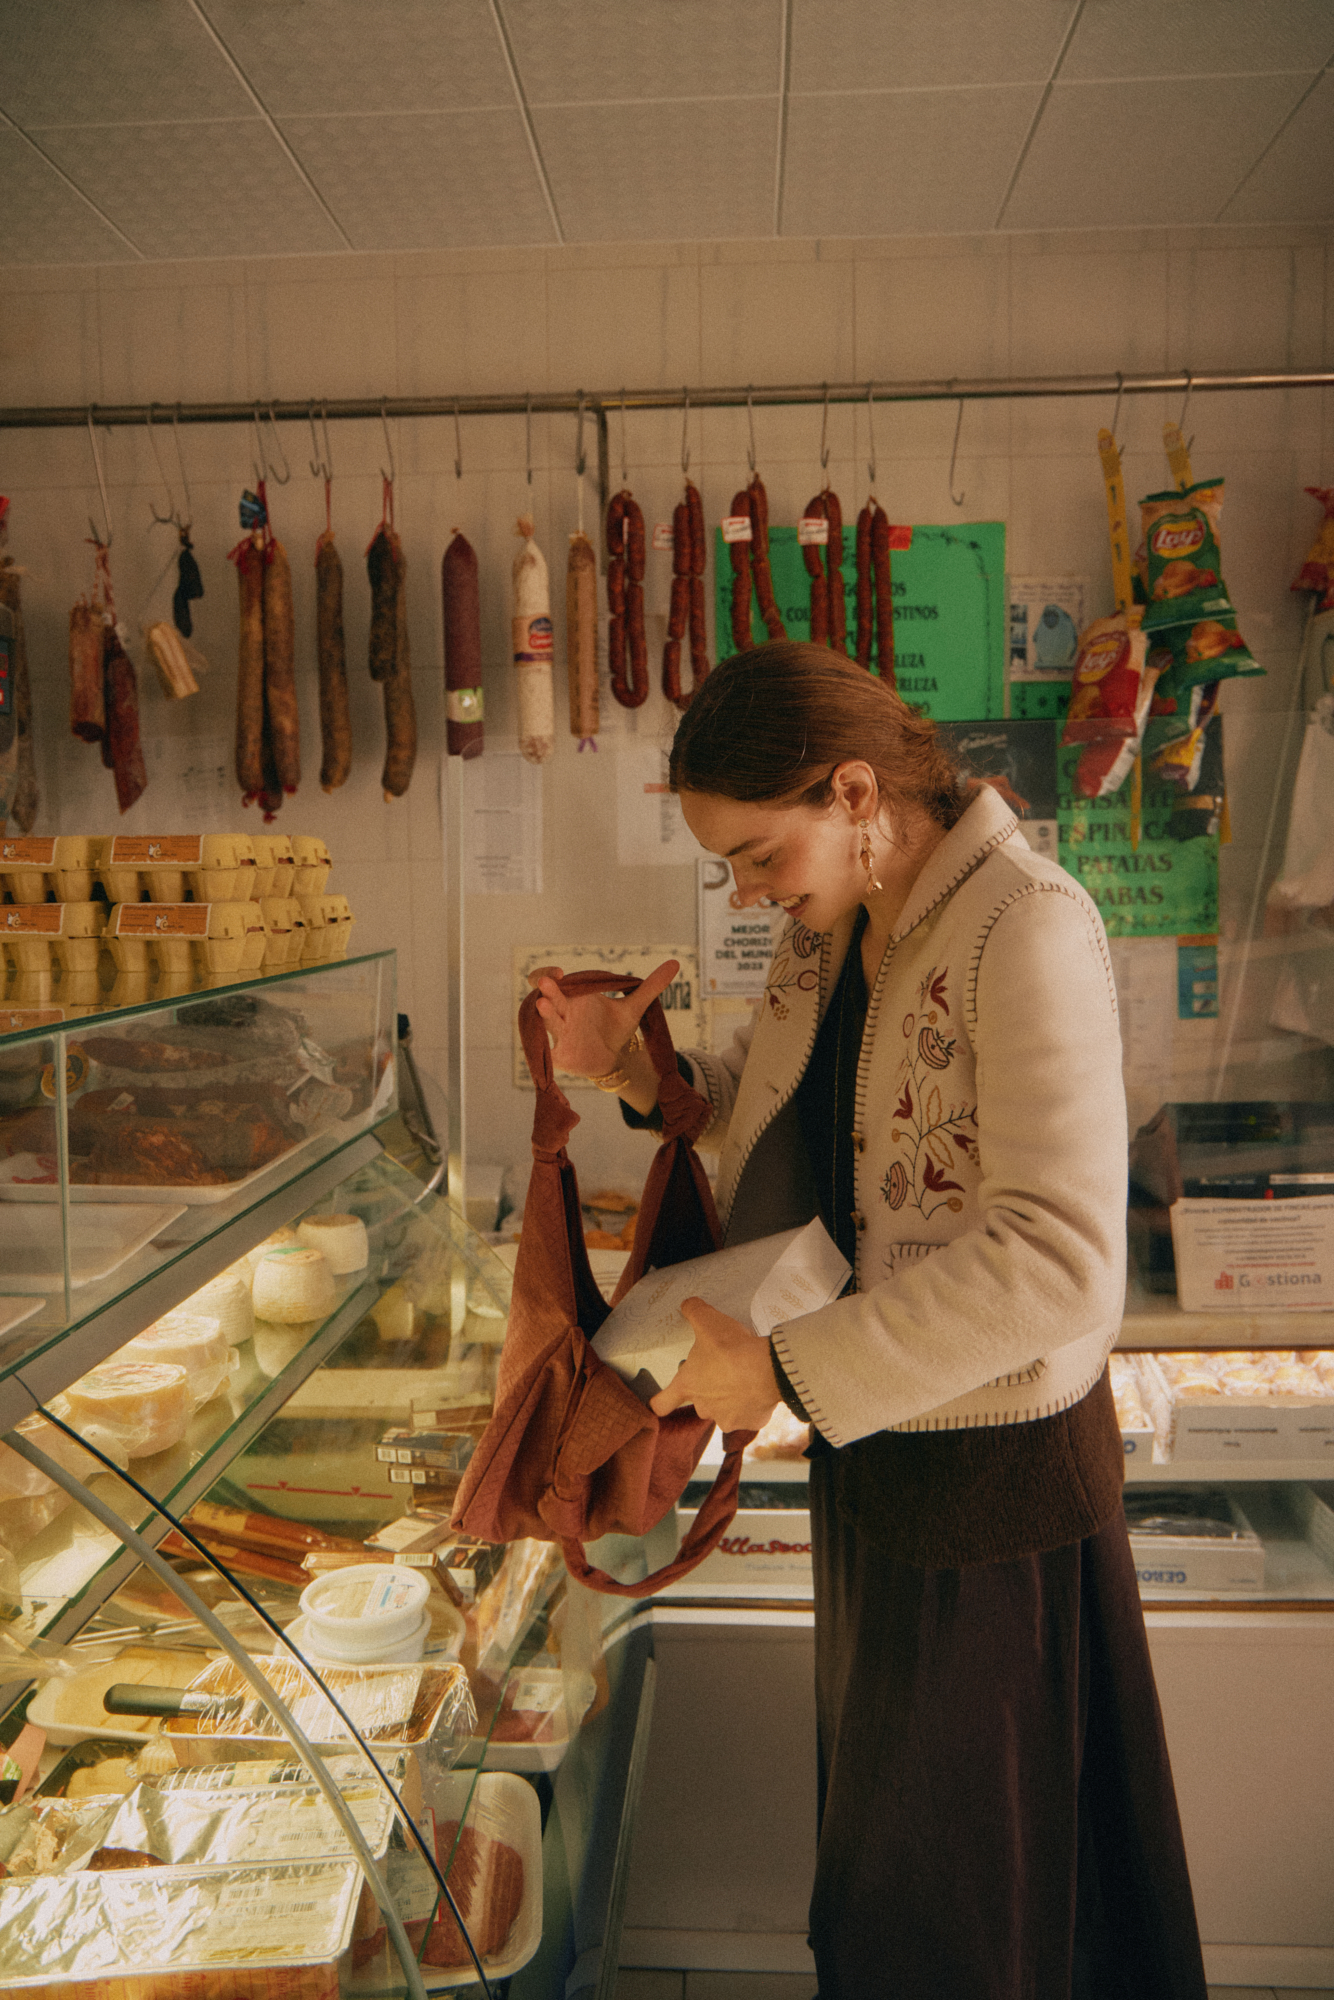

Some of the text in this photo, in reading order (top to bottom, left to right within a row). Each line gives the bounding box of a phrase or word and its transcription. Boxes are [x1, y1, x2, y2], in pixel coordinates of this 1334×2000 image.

[1077, 854, 1173, 875] PATATAS
[731, 925, 770, 934] MEJOR
[715, 949, 737, 959] DEL
